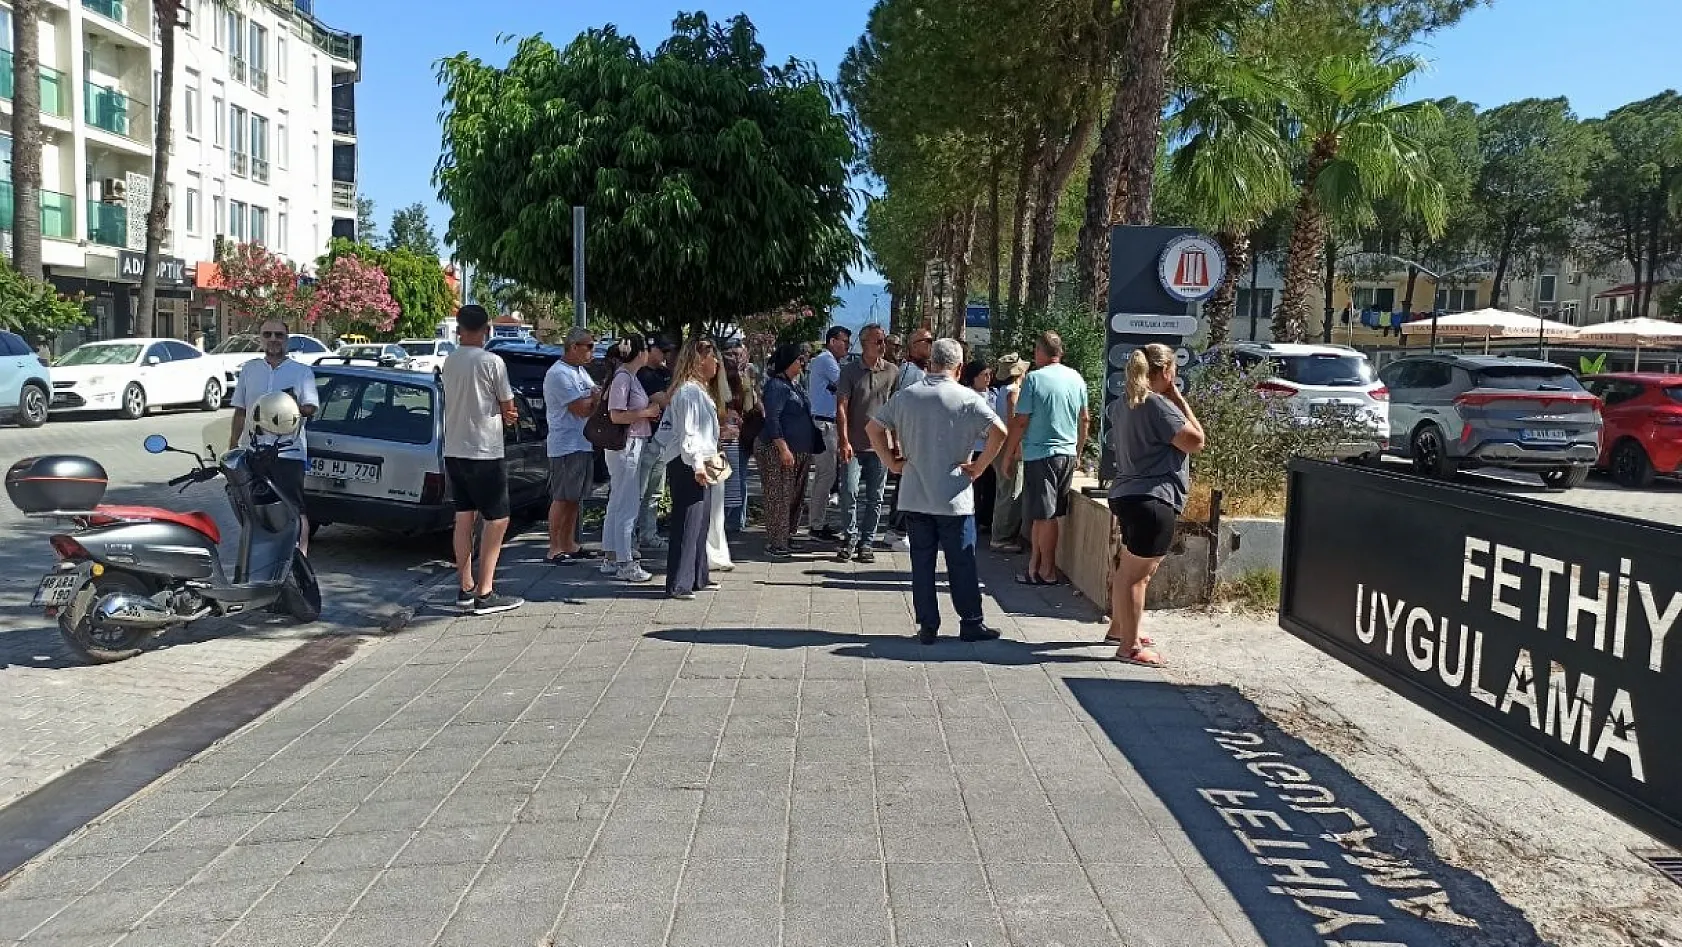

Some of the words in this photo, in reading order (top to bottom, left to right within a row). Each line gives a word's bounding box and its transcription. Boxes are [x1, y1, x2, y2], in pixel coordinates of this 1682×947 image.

[312, 459, 324, 472] 48
[332, 461, 347, 474] HJ
[354, 463, 376, 477] 770
[1461, 536, 1682, 673] FETHİY
[1355, 583, 1646, 783] UYGULAMA
